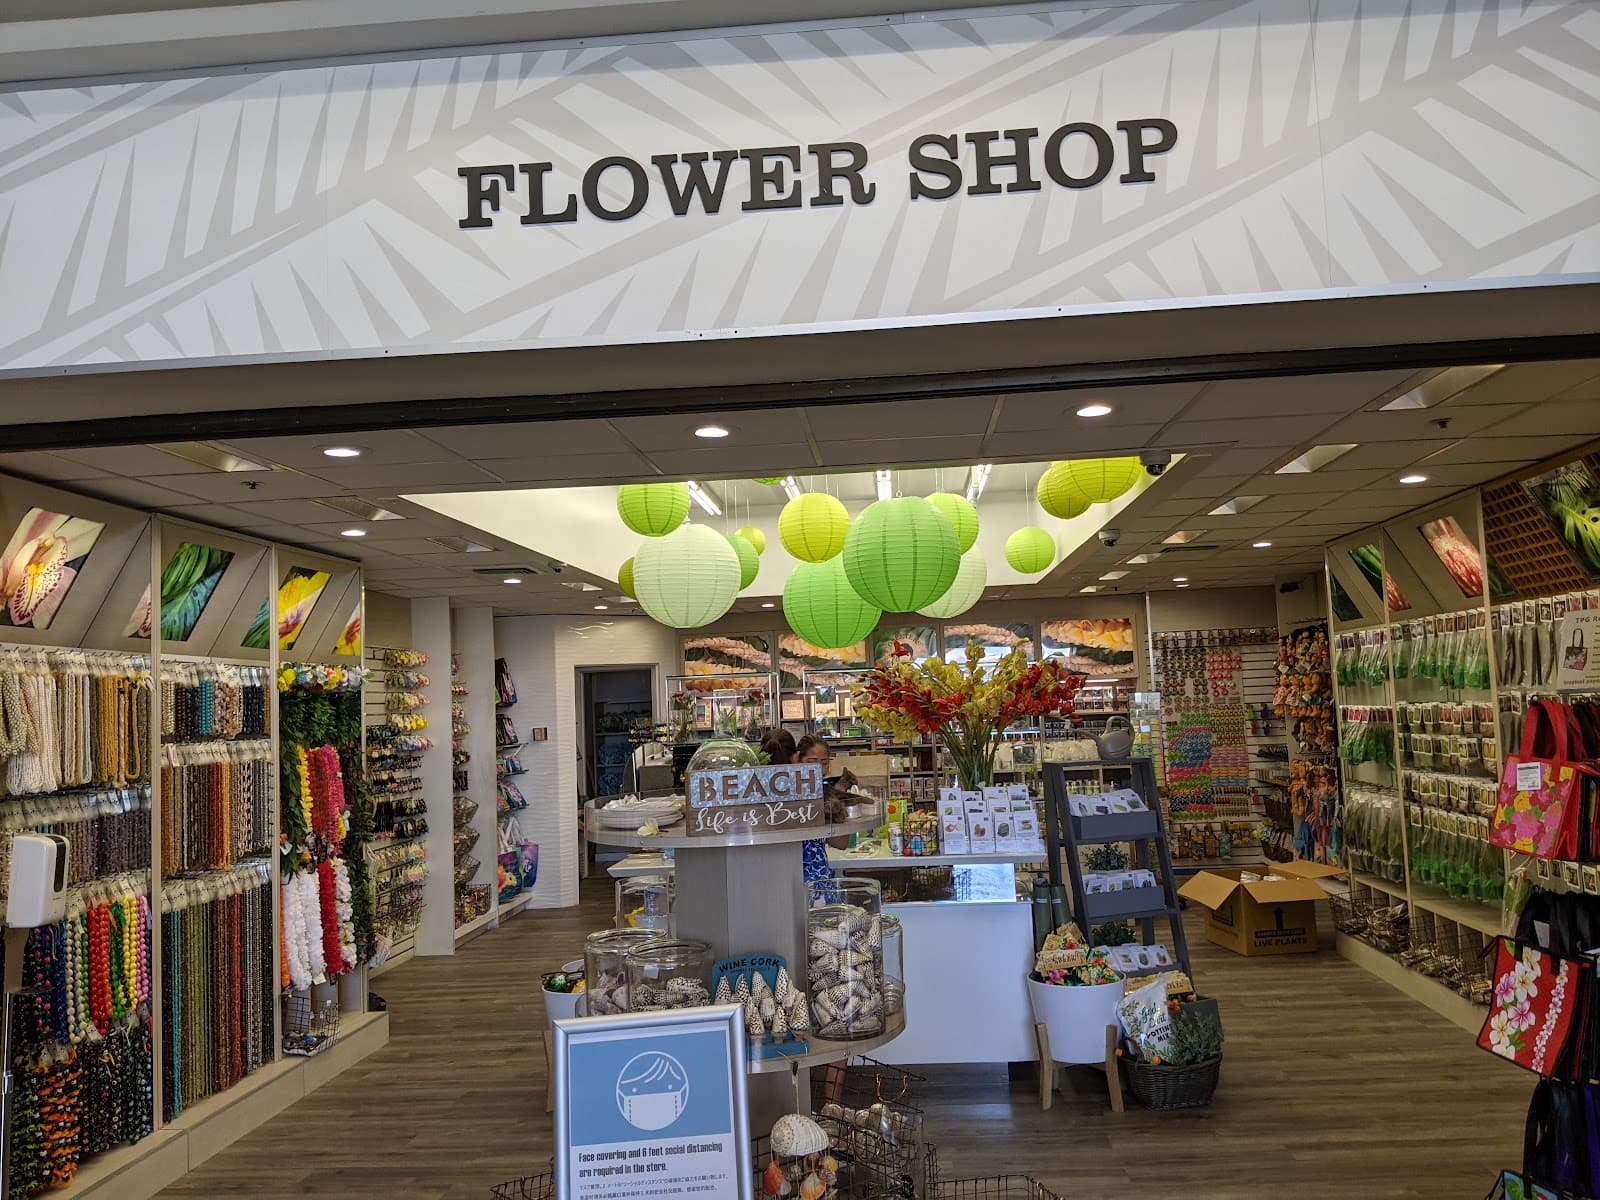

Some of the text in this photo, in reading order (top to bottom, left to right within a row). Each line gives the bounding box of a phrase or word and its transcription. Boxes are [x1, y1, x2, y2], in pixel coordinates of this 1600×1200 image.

[457, 118, 1178, 229] FLOWER SHOP
[698, 769, 816, 802] BEACH
[695, 801, 819, 835] Life is Best
[718, 958, 747, 973] WINE
[750, 957, 780, 968] CORK
[1157, 1032, 1170, 1043] MIX
[578, 1141, 723, 1163] Face covering and 6 feet social distancing
[578, 1162, 668, 1178] are required in the store.
